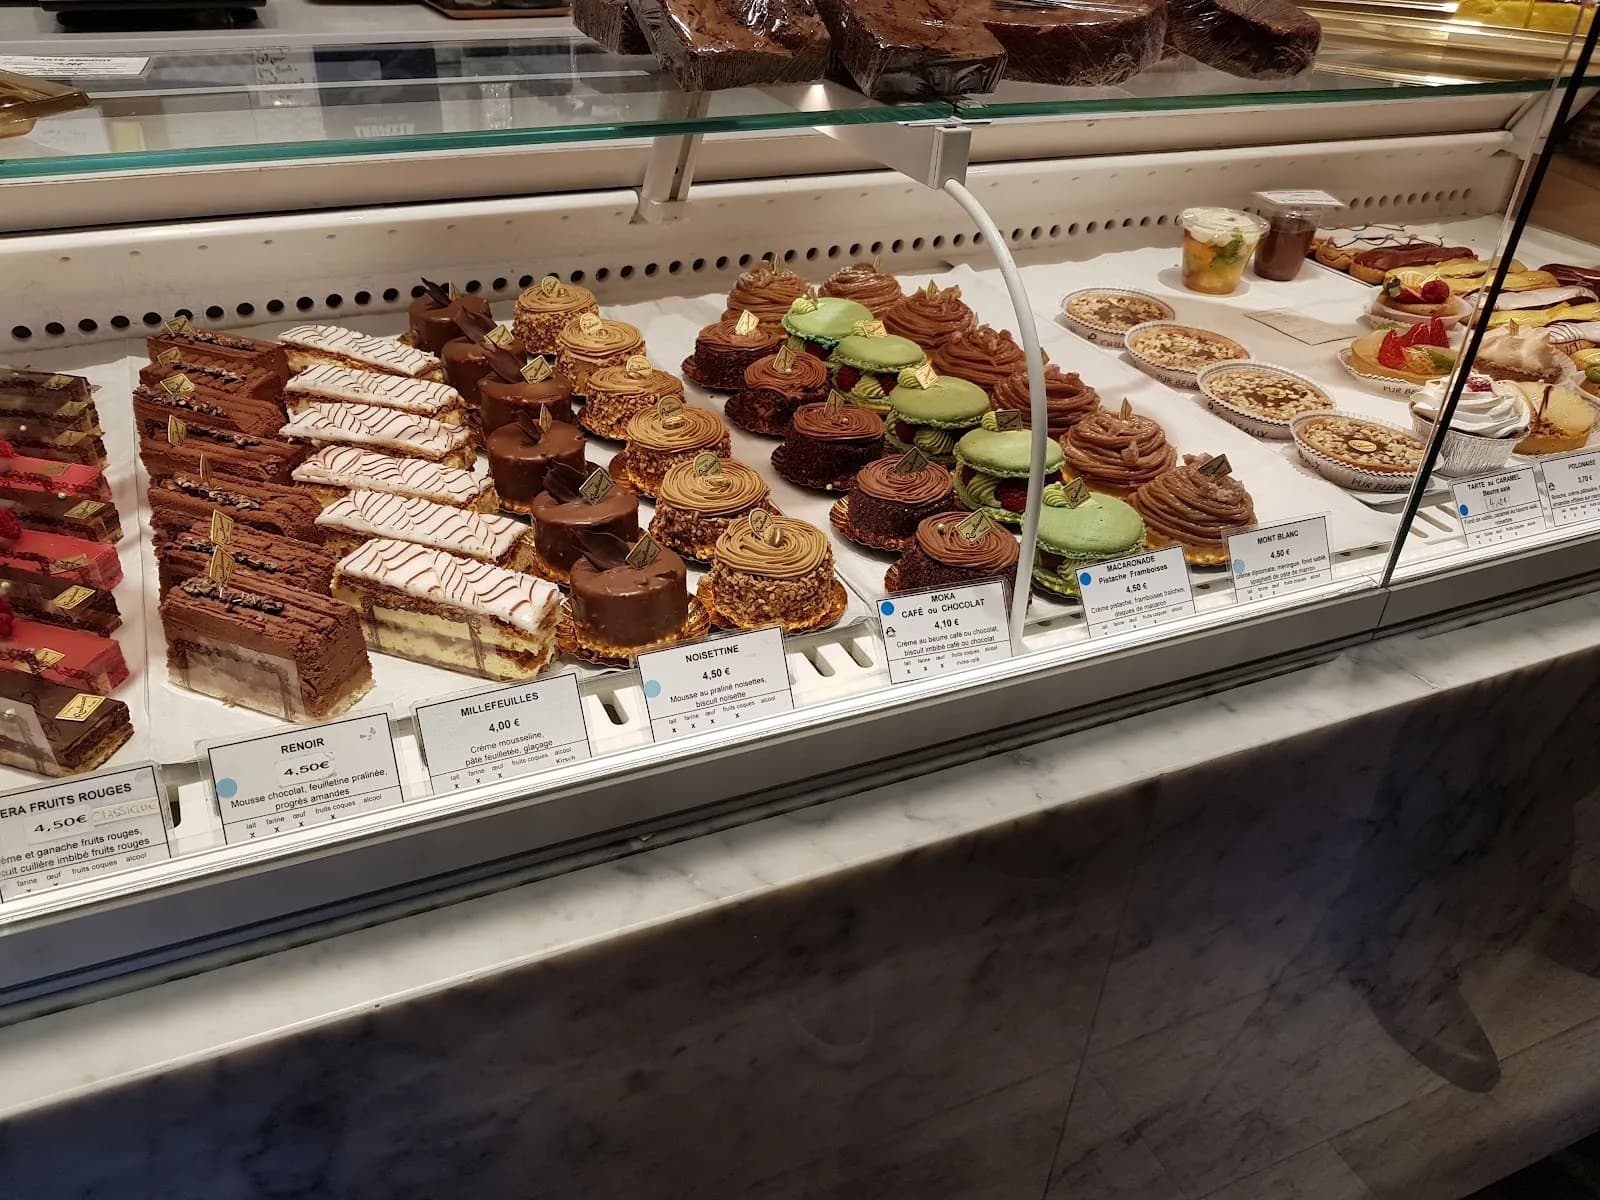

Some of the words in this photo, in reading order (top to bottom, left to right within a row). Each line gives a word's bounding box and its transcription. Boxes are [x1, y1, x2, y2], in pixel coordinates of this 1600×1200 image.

[1467, 482, 1485, 490] TARTE
[1496, 474, 1521, 484] CARAMEL
[1258, 534, 1276, 544] MONT
[1277, 530, 1299, 540] BLANC
[1106, 556, 1156, 572] MACARONADE
[1270, 550, 1284, 559] 4,50
[1098, 574, 1126, 584] Pistache
[1130, 564, 1168, 578] Framboises
[931, 592, 956, 603] MOKA
[902, 607, 924, 618] CAFÉ
[942, 598, 984, 613] CHOCOLAT
[934, 620, 952, 630] 4,10
[896, 640, 917, 648] Crème
[928, 634, 948, 642] beurre
[904, 647, 924, 656] biscuit
[947, 642, 960, 650] café
[970, 635, 994, 645] chocolat
[686, 645, 739, 662] NOISETTINE
[702, 668, 722, 680] 4,50
[725, 667, 730, 676] €
[670, 692, 698, 703] Mousse
[710, 684, 732, 696] praliné
[735, 677, 766, 690] noisettes,
[696, 697, 718, 708] biscuit
[720, 691, 746, 702] noisette
[460, 692, 538, 717] MILLEFEUILLES
[489, 720, 510, 732] 4,00
[514, 718, 520, 727] €
[280, 738, 324, 754] RENOIR
[470, 742, 496, 754] Crème
[499, 732, 544, 746] mousseline,
[466, 754, 482, 767] pâte
[484, 746, 522, 761] feuilletée,
[524, 740, 552, 754] glaçage
[468, 768, 485, 778] farine
[512, 758, 526, 766] fruits
[555, 747, 572, 756] alcool
[556, 755, 576, 765] Kirsch
[231, 794, 266, 808] Mousse
[268, 786, 308, 801] chocolat,
[309, 778, 350, 792] feuilletine
[352, 769, 388, 784] pralinée,
[0, 806, 27, 819] ERA
[30, 795, 75, 812] FRUITS
[78, 783, 132, 802] ROUGES
[276, 796, 308, 812] progrès
[310, 788, 350, 803] amandes
[246, 822, 256, 830] lait
[266, 816, 285, 826] farine
[292, 810, 306, 819] œuf
[315, 805, 331, 814] fruits
[333, 801, 356, 812] coques
[363, 794, 382, 804] alcool
[25, 849, 34, 859] et
[38, 842, 78, 859] ganache
[81, 835, 105, 848] fruits
[108, 828, 142, 842] rouges,
[20, 858, 54, 873] cuillère
[58, 850, 89, 865] imbibé
[92, 846, 115, 858] fruits
[118, 838, 150, 851] rouges
[17, 877, 38, 886] farine
[46, 872, 62, 880] œuf
[72, 866, 90, 874] fruits
[92, 860, 118, 871] coques
[126, 854, 147, 862] alcool
